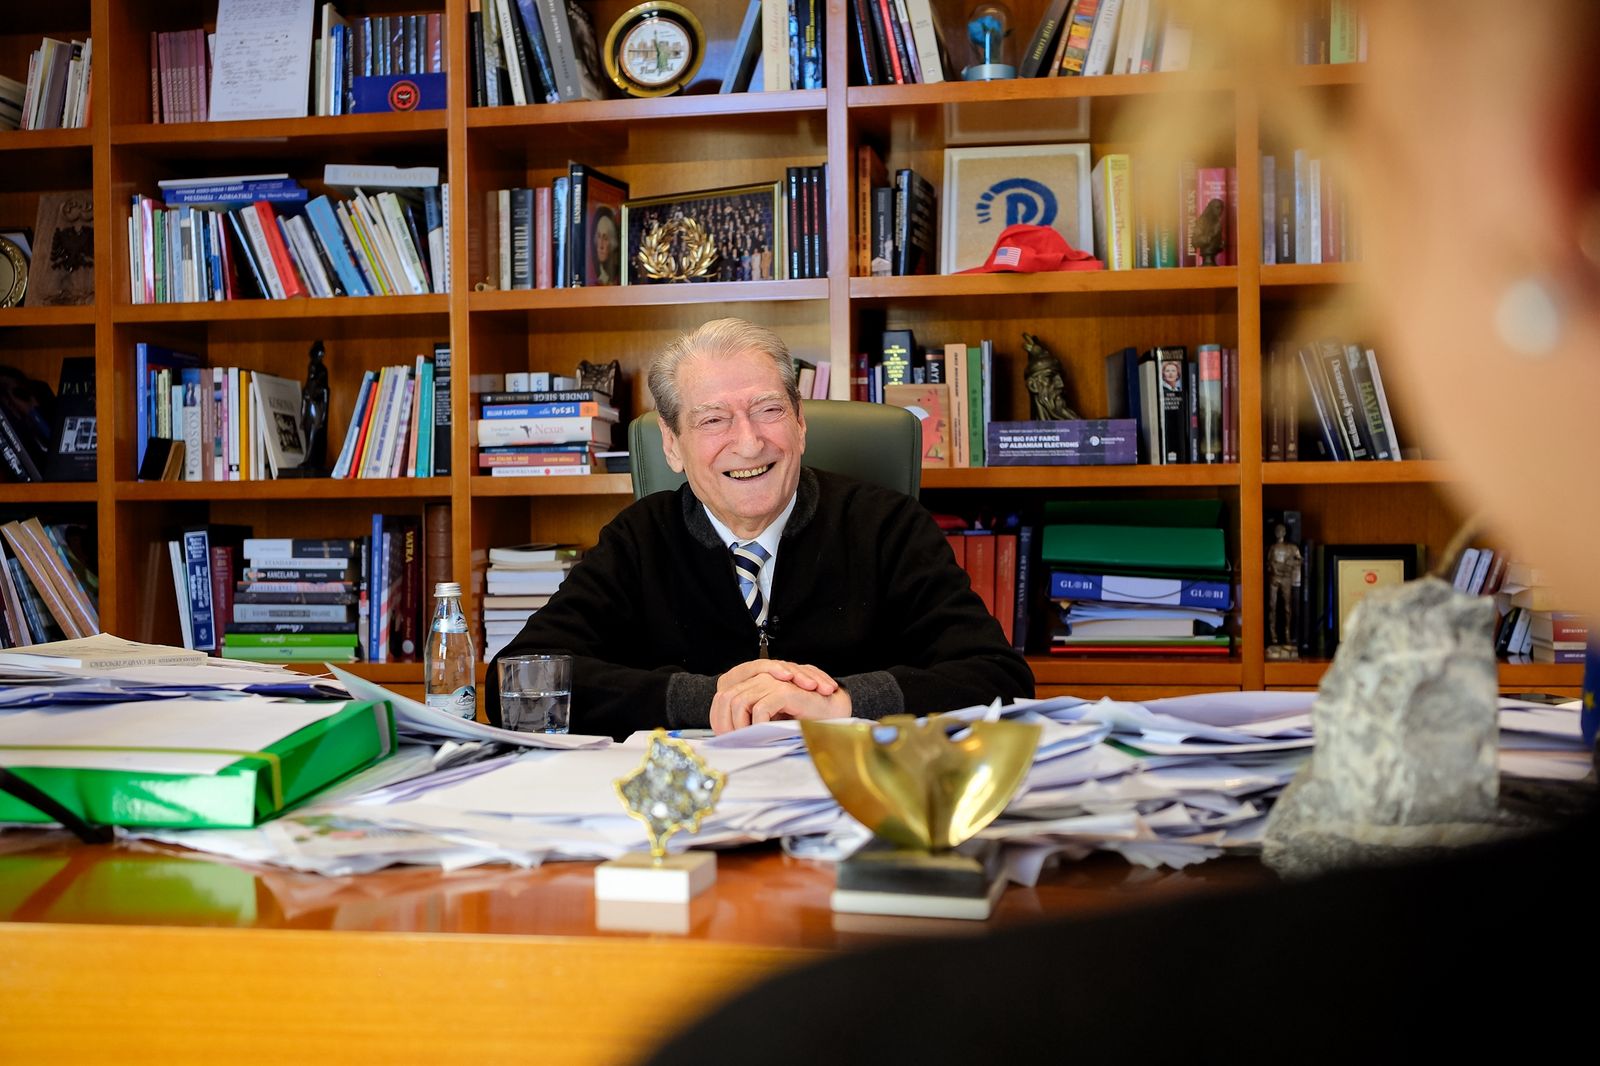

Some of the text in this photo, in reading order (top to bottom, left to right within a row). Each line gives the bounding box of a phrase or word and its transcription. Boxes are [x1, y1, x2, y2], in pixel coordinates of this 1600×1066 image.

[513, 223, 529, 279] CHURCHILL
[533, 393, 558, 402] SIEGE
[559, 392, 590, 401] UNDER
[534, 423, 565, 434] Nexus
[188, 410, 200, 467] KOSOVO
[1025, 434, 1038, 442] FAT
[1038, 434, 1060, 442] FARCE
[405, 530, 415, 564] VATRA
